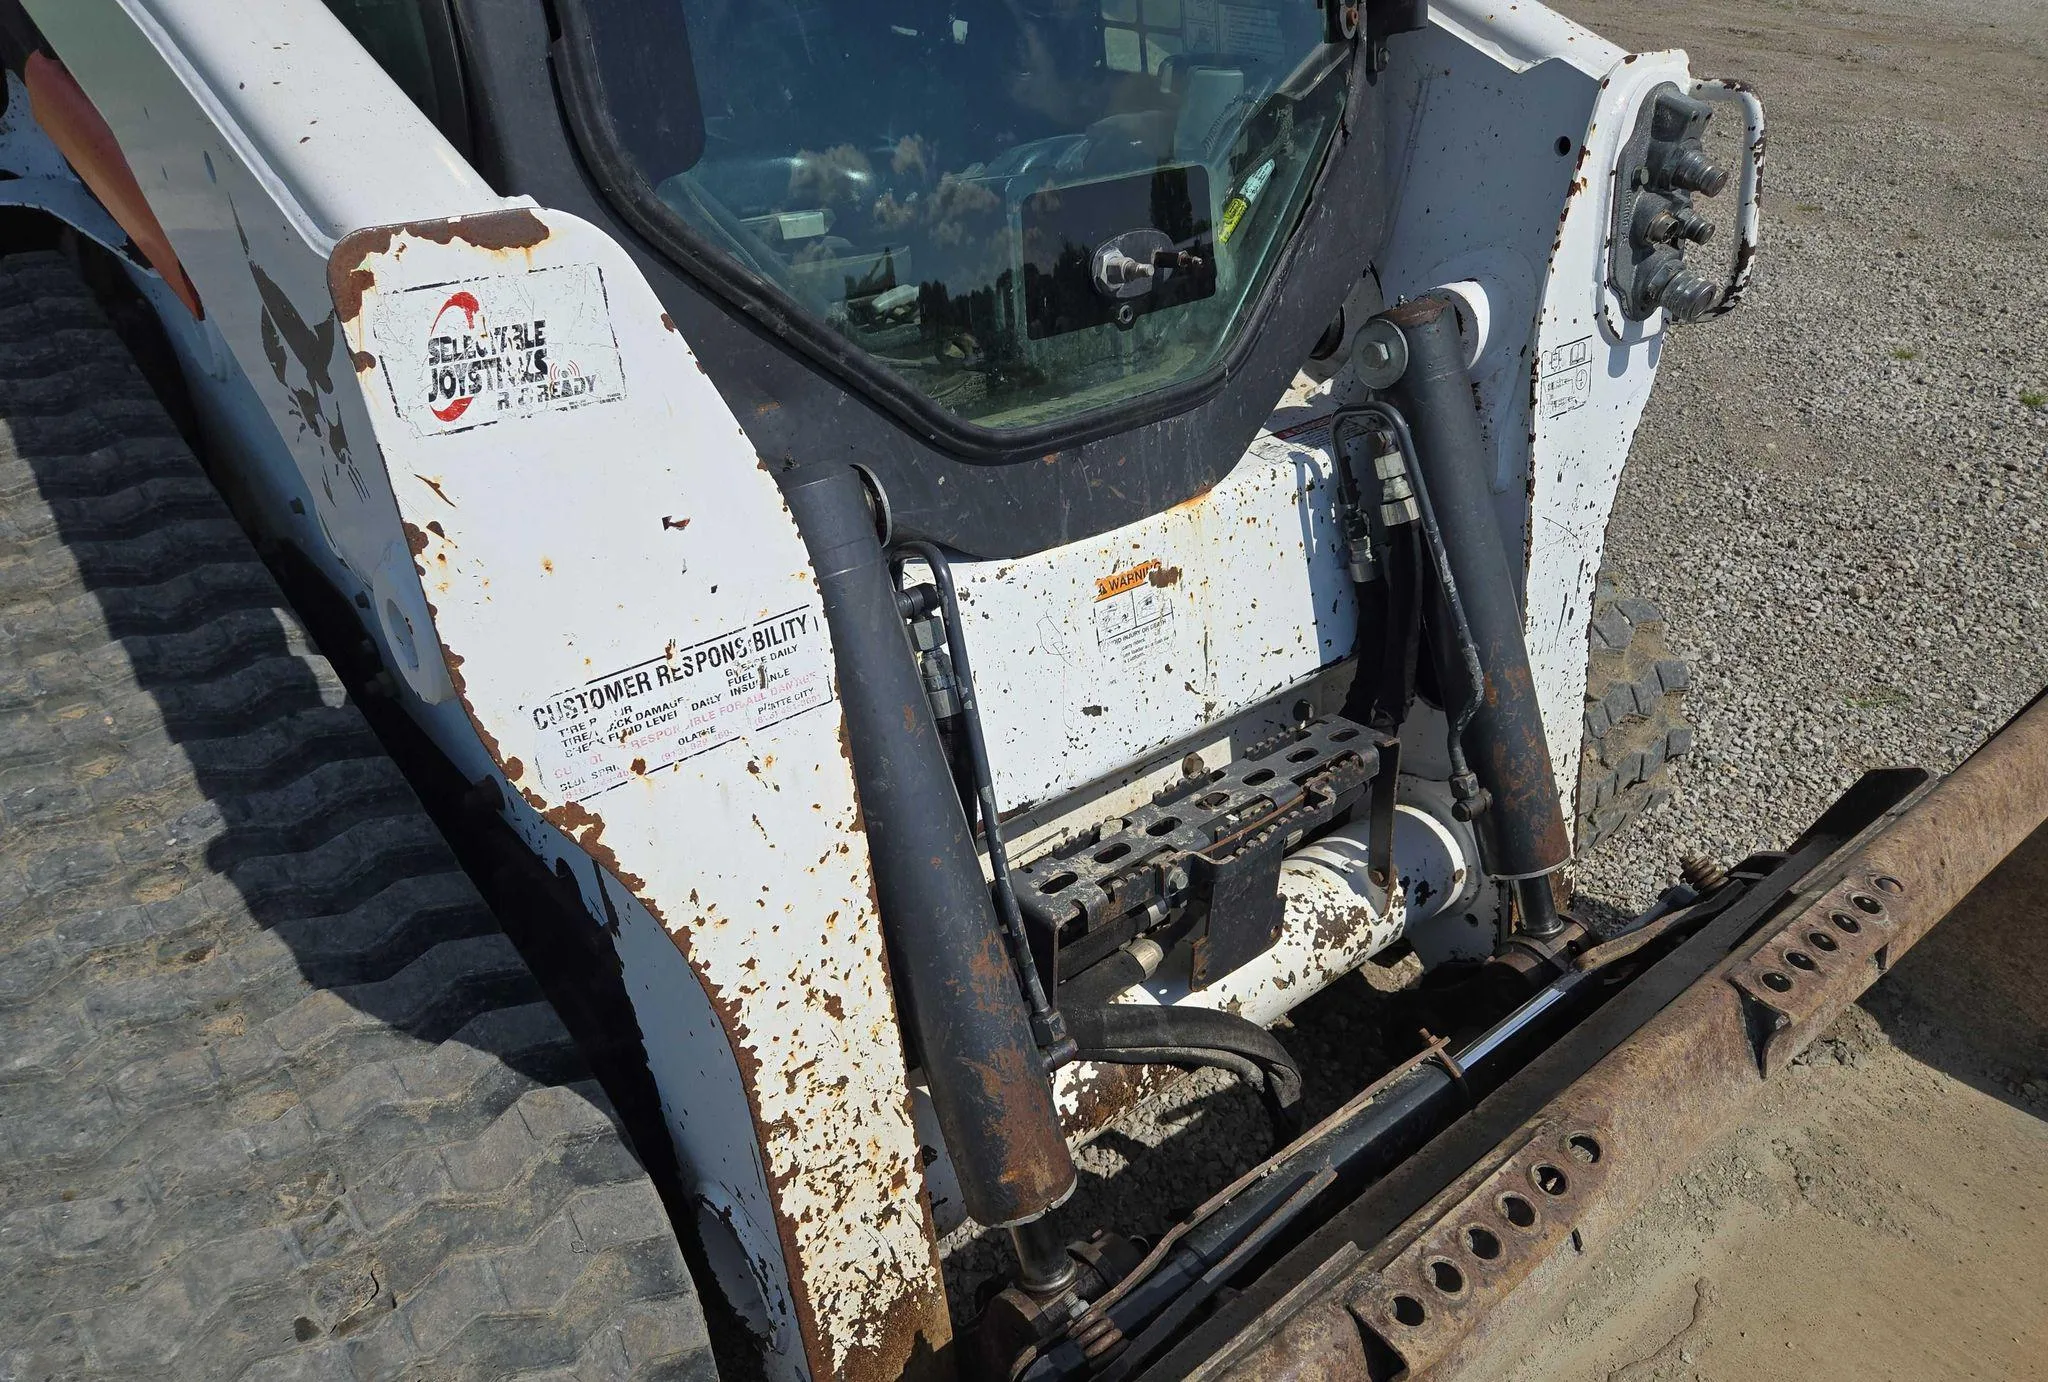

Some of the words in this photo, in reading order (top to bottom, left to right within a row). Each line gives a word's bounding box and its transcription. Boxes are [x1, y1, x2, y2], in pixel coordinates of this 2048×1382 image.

[770, 644, 799, 661] DAILY
[728, 671, 755, 687] FUEL
[730, 668, 791, 697] INSUNCE
[532, 671, 653, 731] CUSTOMER
[794, 687, 814, 701] CITY
[609, 724, 642, 744] FLID
[691, 693, 722, 712] DAILY
[631, 711, 717, 749] RESPONIBLE
[746, 691, 767, 706] ALL
